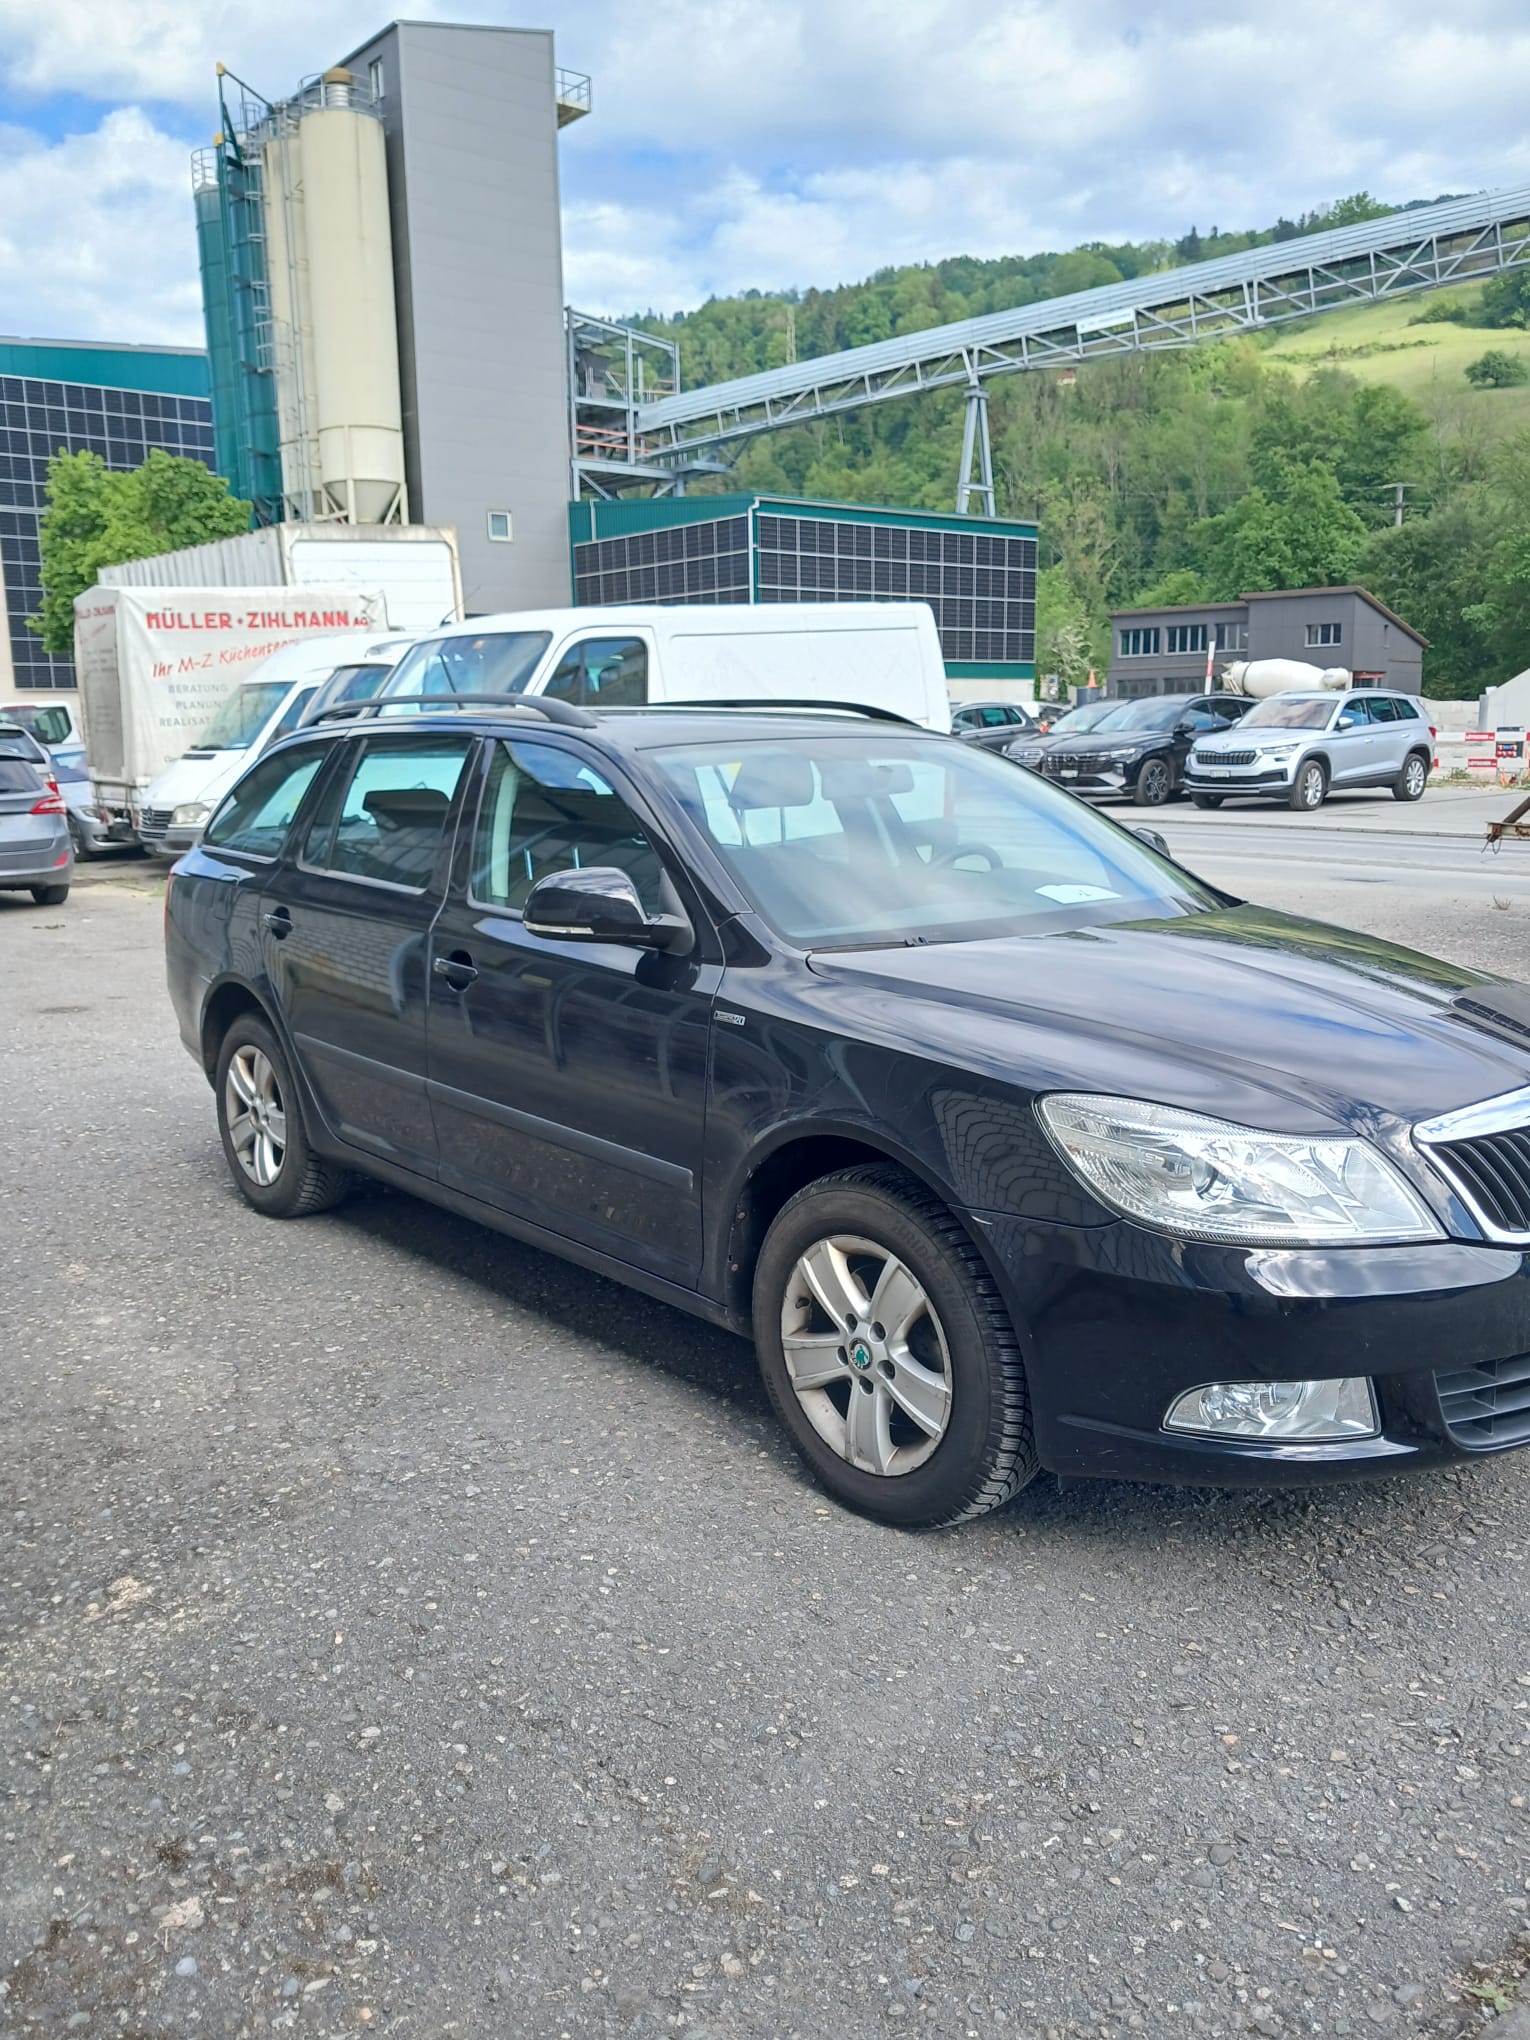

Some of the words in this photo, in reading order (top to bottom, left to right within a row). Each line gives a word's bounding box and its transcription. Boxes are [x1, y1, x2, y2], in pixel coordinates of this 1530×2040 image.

[152, 662, 173, 677] Ihr
[178, 652, 213, 673] M-Z
[168, 684, 228, 694] BERATUNG
